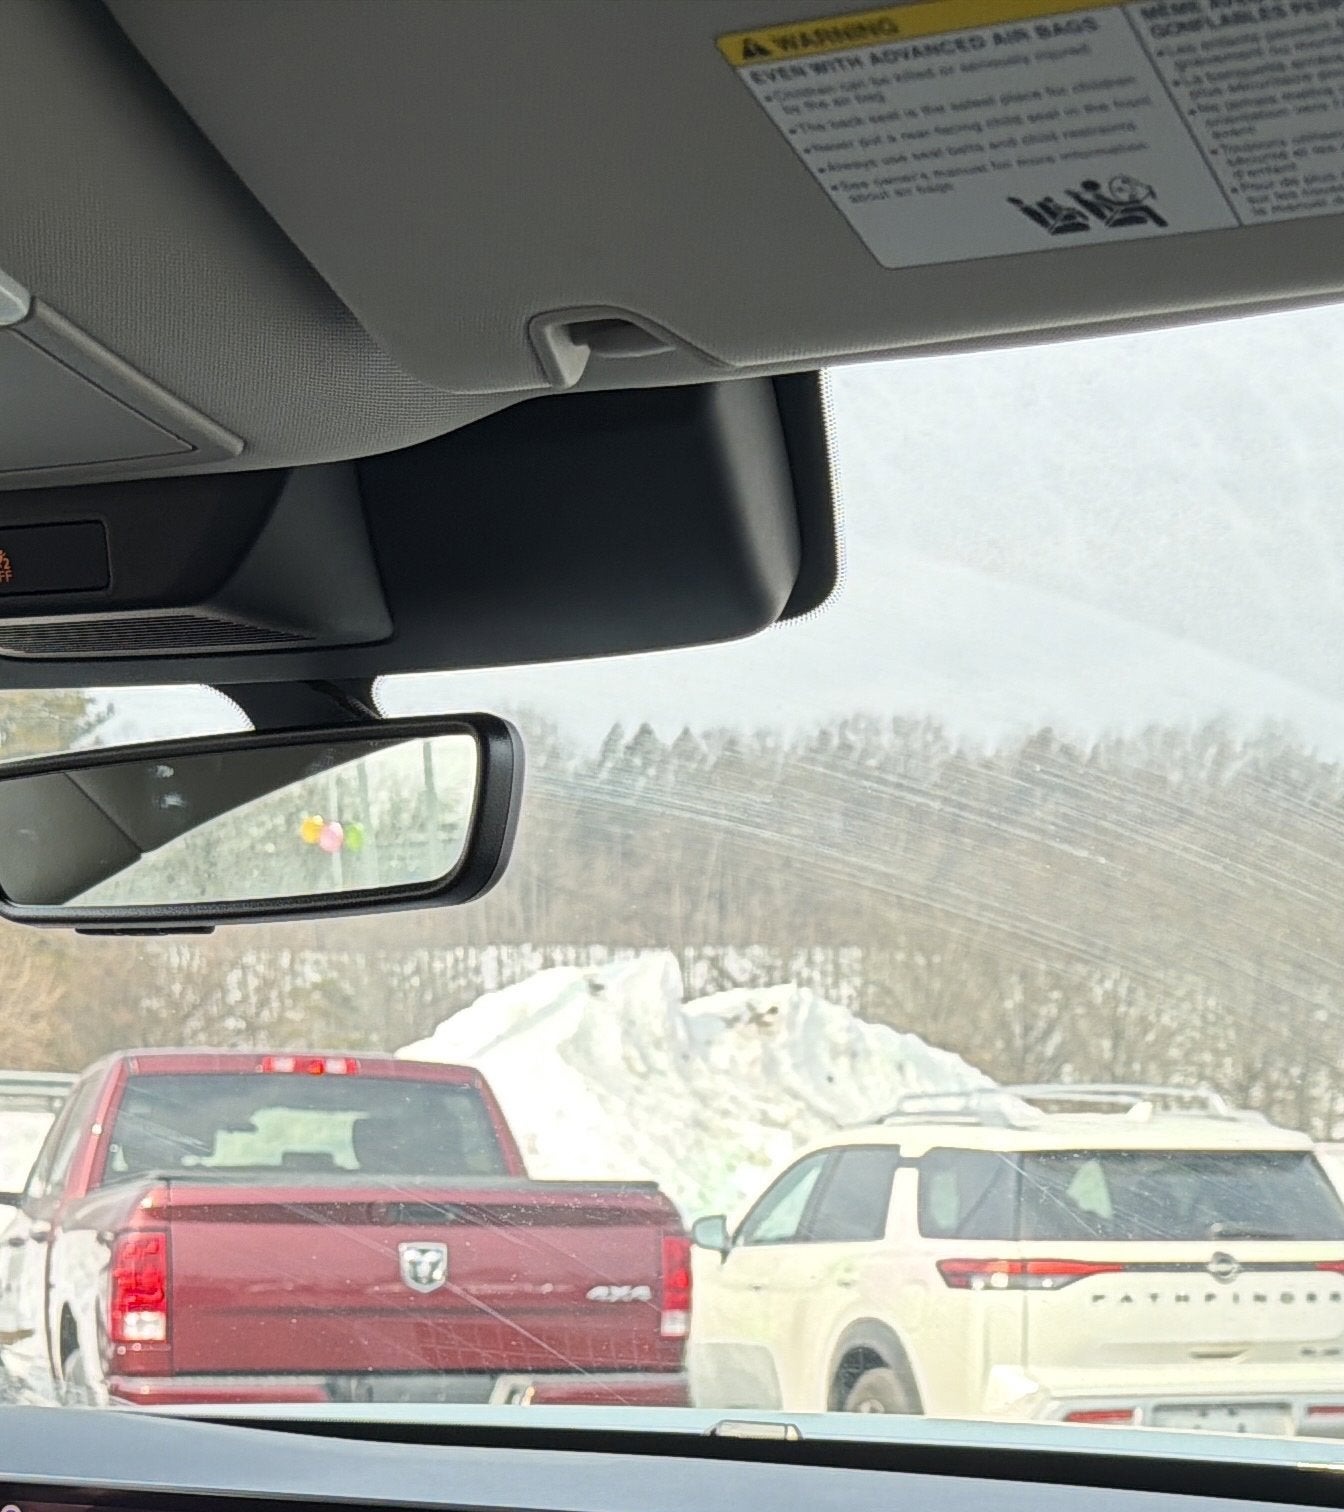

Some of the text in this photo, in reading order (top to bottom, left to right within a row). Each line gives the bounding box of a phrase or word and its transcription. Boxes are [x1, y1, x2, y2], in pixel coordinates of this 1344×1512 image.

[750, 17, 1099, 85] EVEN WITH ADVANCED AIR BAGS
[775, 19, 899, 51] WARNING
